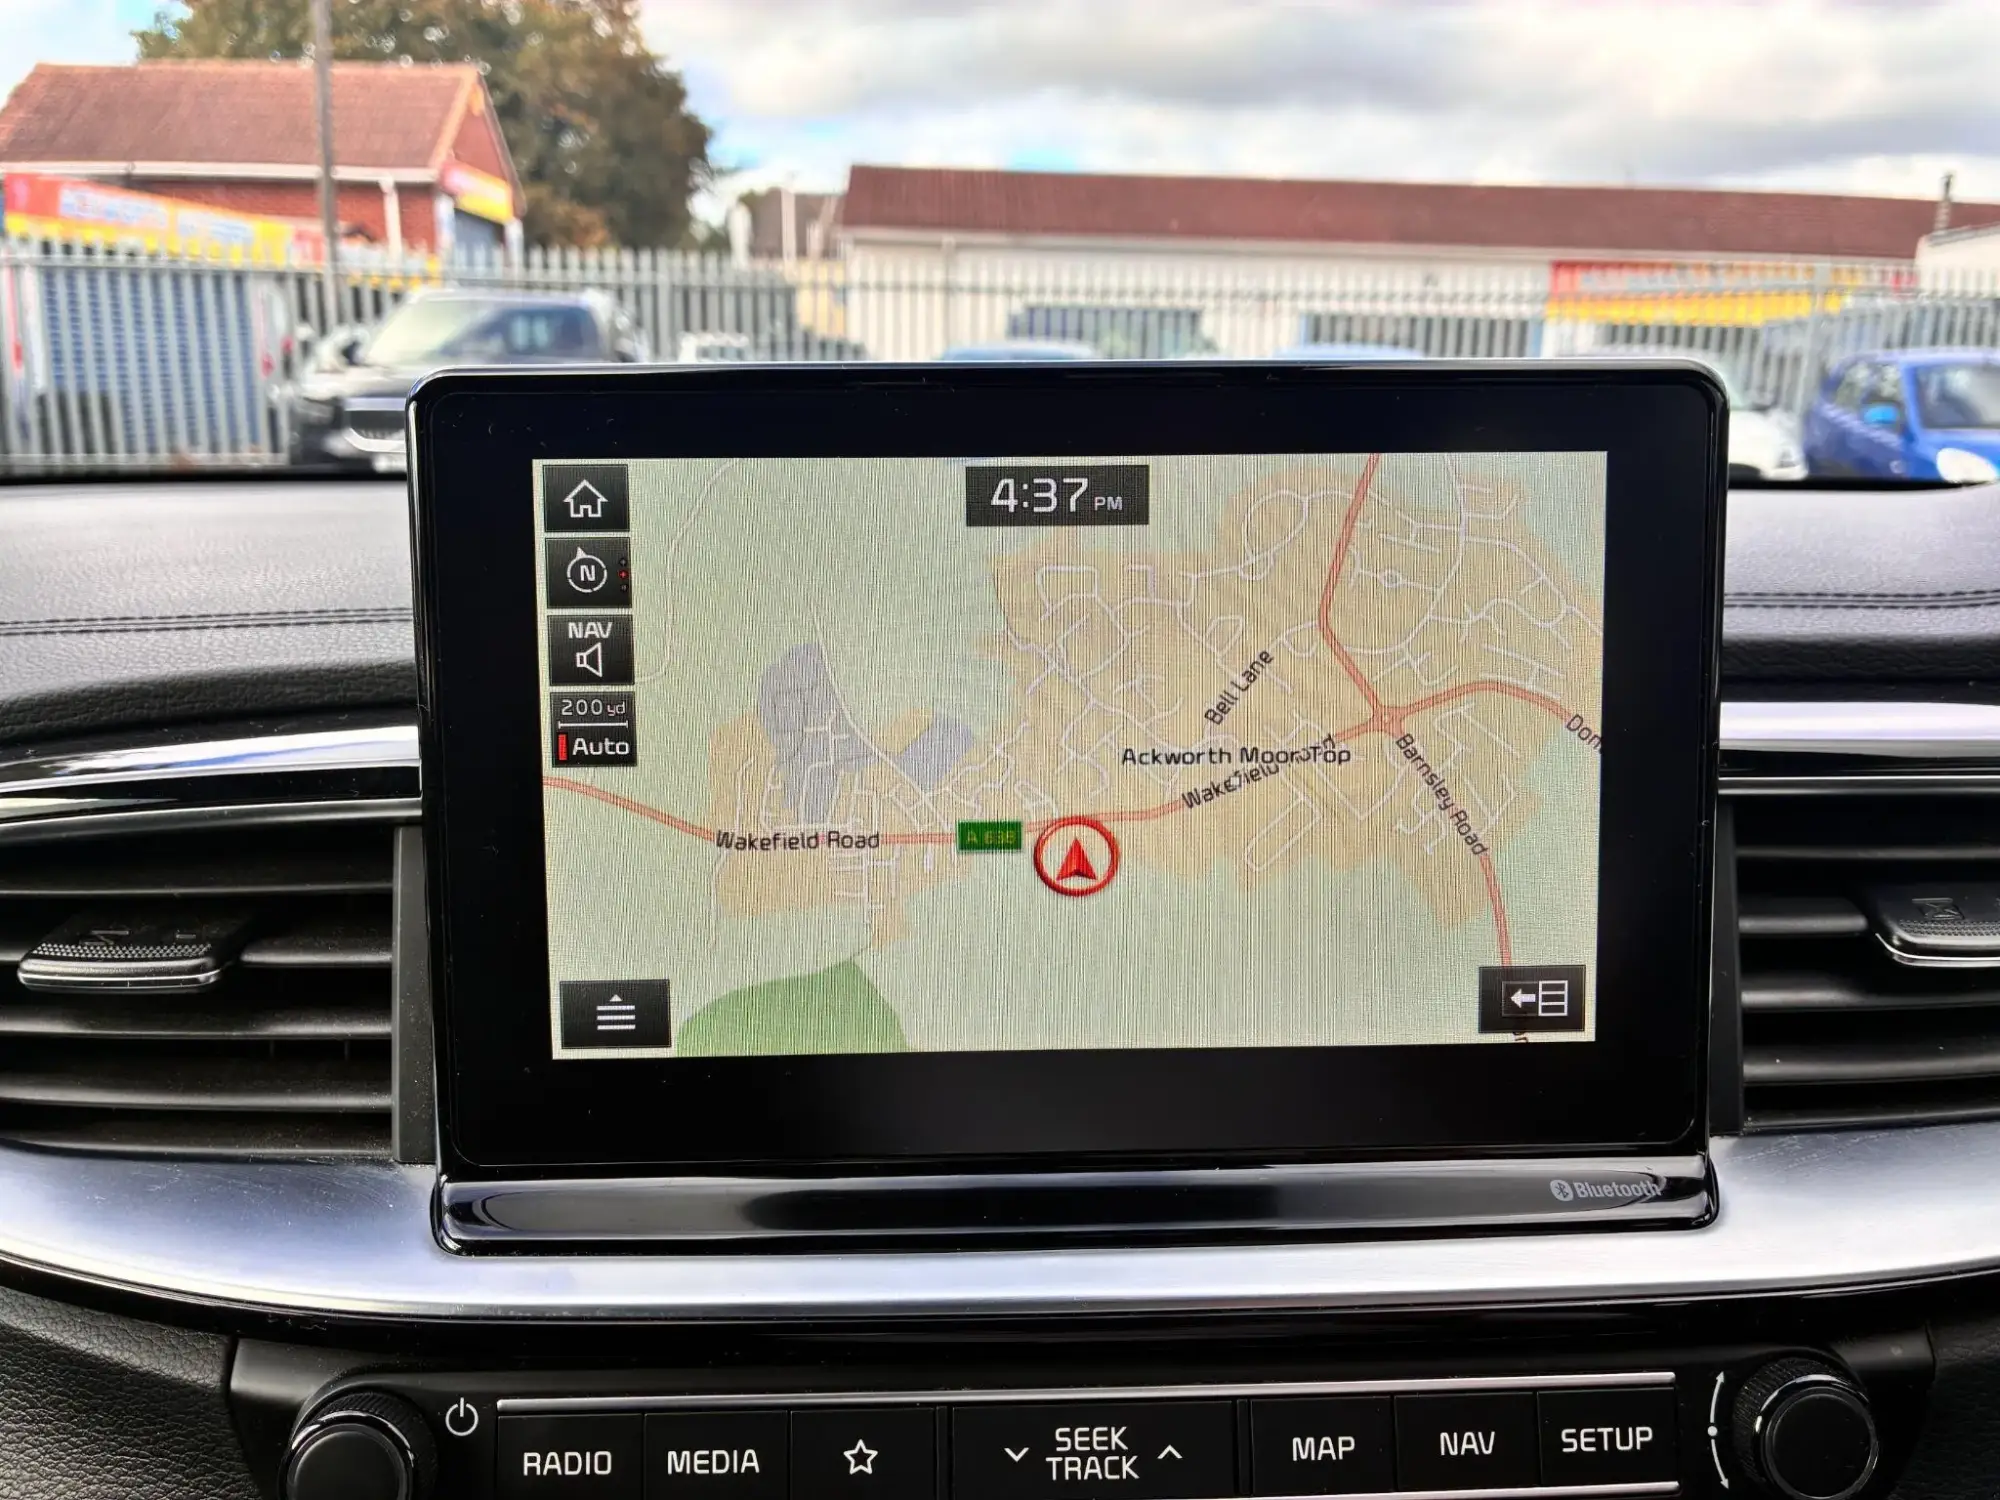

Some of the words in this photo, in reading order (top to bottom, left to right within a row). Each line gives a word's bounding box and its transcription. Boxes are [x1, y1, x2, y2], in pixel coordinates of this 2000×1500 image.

[990, 477, 1089, 513] 4:37
[1094, 496, 1123, 511] PM
[580, 564, 596, 582] N
[567, 621, 613, 639] NAV
[1204, 691, 1238, 725] Bell
[1232, 650, 1274, 693] Lane
[560, 699, 603, 716] 200
[607, 702, 626, 718] yd
[572, 737, 630, 756] Auto
[1121, 747, 1232, 765] Ackworth
[1396, 733, 1454, 811] Barnsley
[1450, 809, 1488, 856] Road
[716, 830, 819, 850] Wakefield
[827, 830, 880, 850] Road
[1573, 1180, 1662, 1199] Bluetooth
[1055, 1426, 1128, 1452] SEEK
[1292, 1436, 1356, 1461] MAP
[1439, 1431, 1496, 1456] NAV
[1561, 1427, 1653, 1452] SETUP
[522, 1451, 612, 1477] RADIO
[667, 1449, 760, 1475] MEDIA
[1045, 1455, 1140, 1481] TRACK
